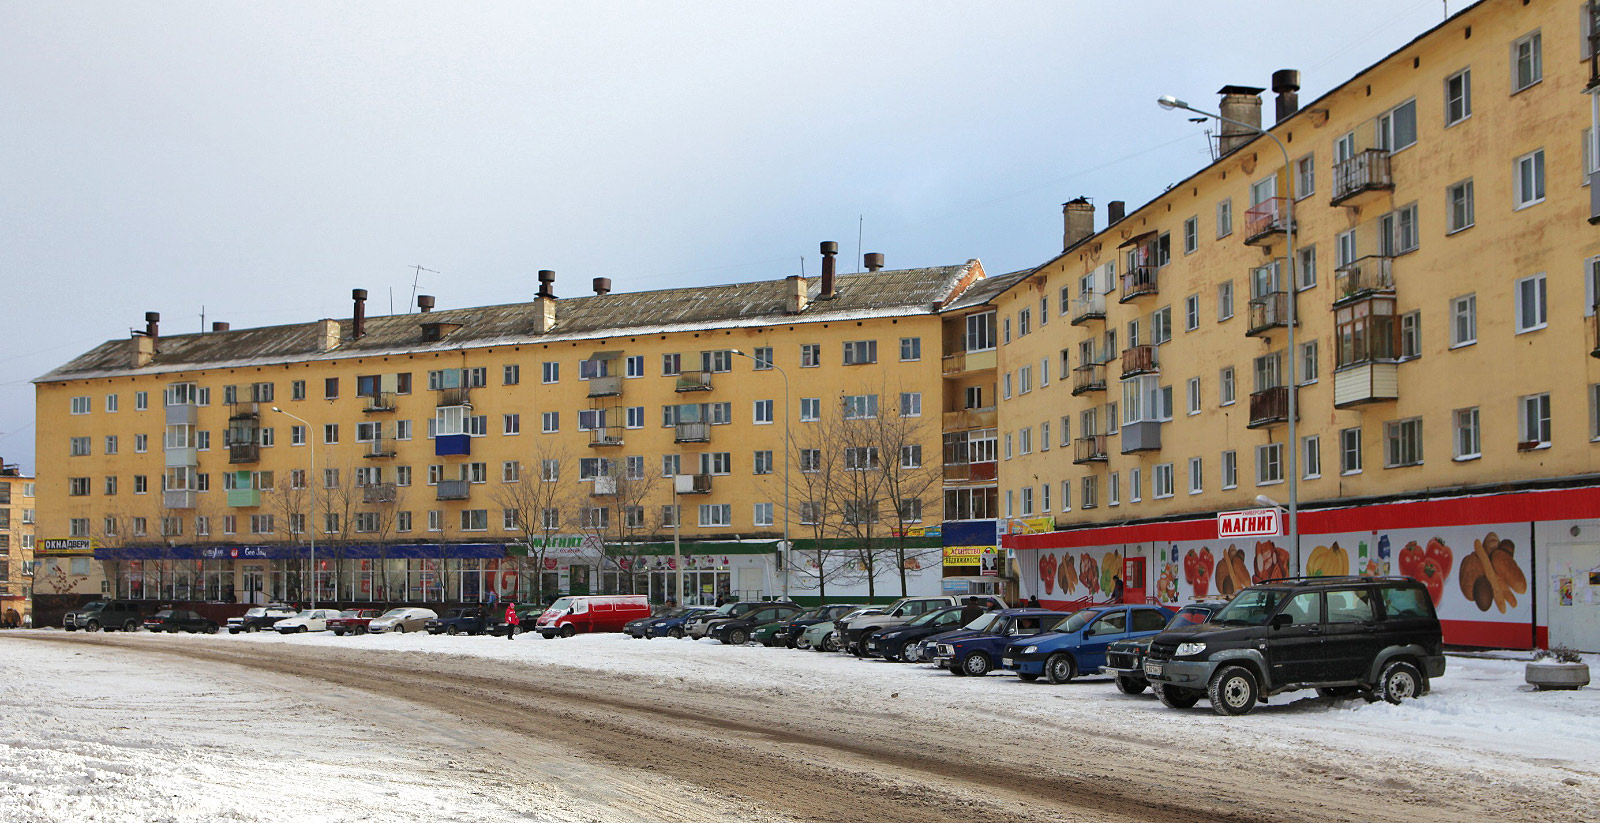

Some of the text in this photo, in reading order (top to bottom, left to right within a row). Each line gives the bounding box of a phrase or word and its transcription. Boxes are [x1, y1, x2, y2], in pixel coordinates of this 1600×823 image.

[1221, 515, 1273, 533] МАГНИТ
[45, 540, 90, 550] ОКНА ДВЕРИ
[534, 538, 583, 547] МАГНИТ
